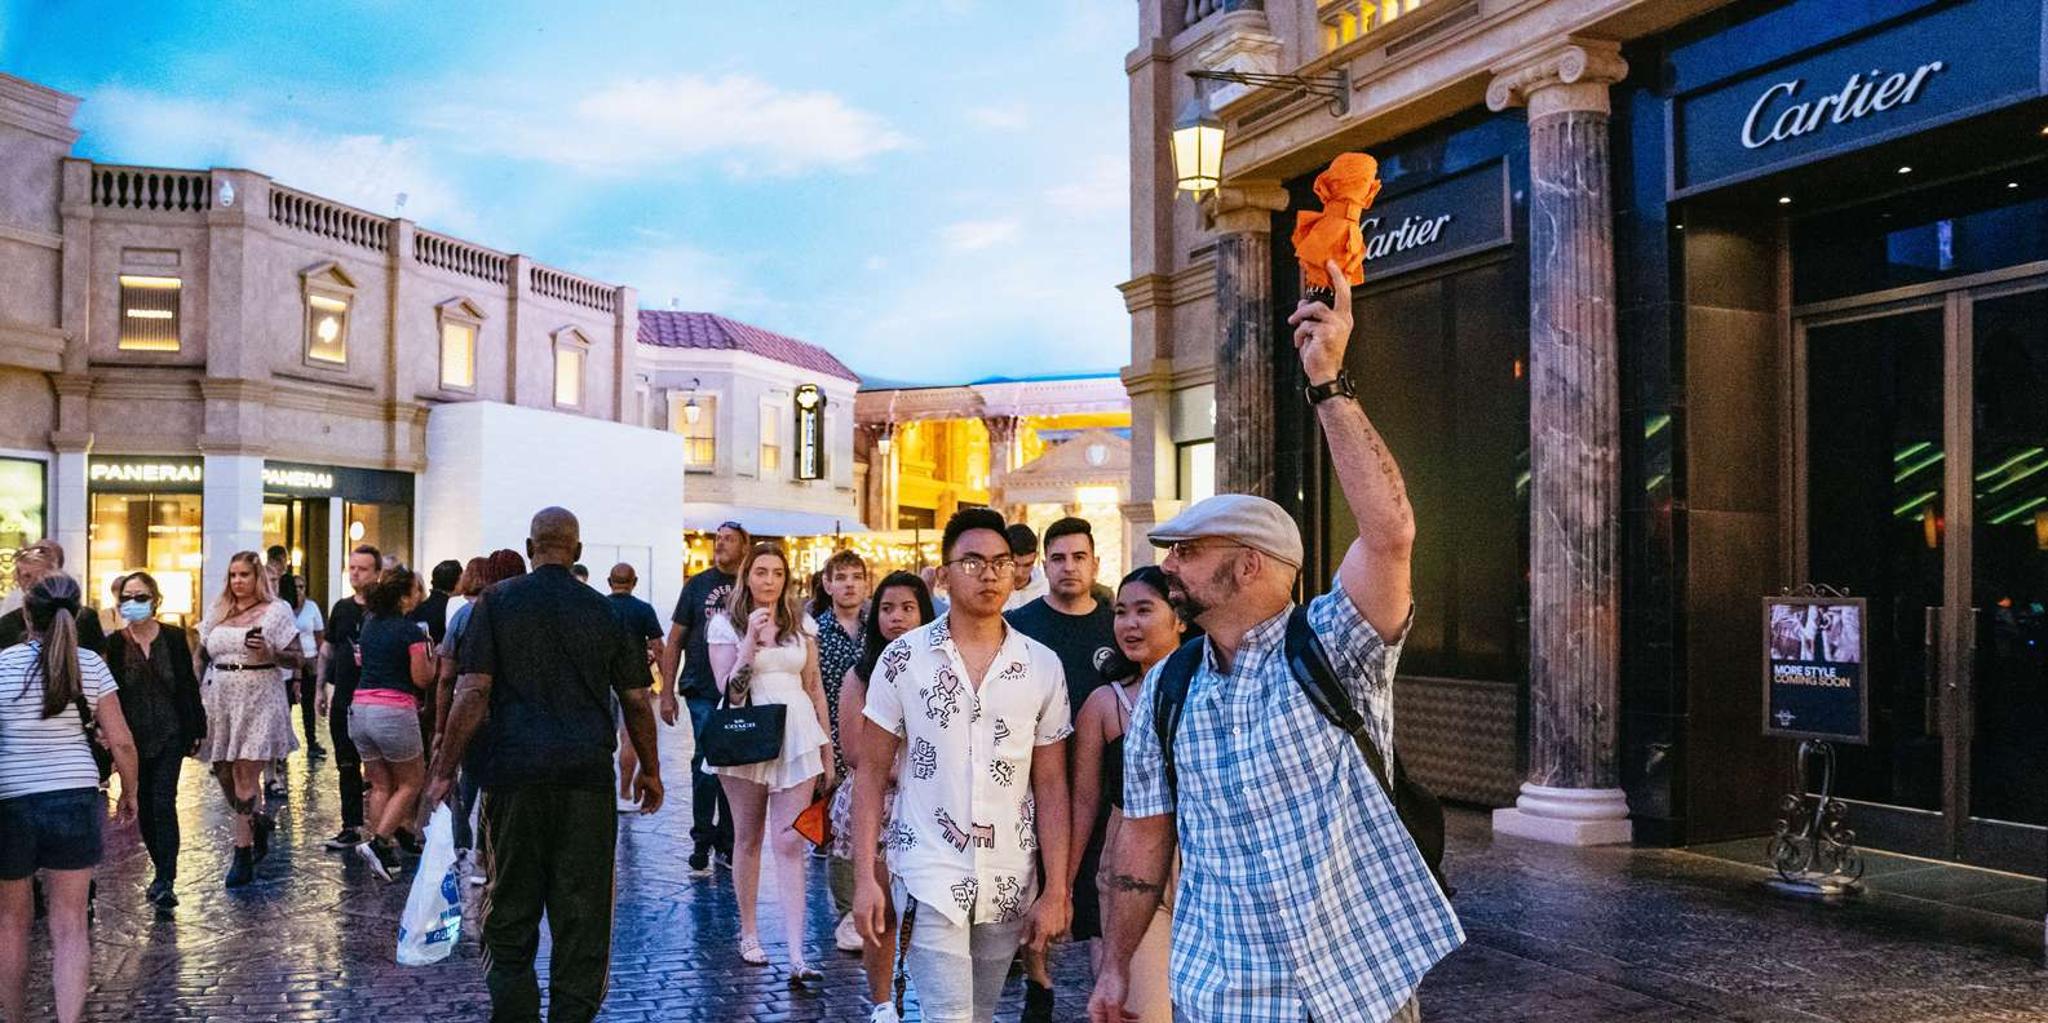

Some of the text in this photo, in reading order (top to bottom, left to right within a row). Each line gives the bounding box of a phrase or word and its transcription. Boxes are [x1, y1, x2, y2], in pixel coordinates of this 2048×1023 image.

[1741, 60, 1943, 149] Cartier
[90, 464, 201, 481] PANERAI
[262, 469, 333, 489] PANERAI
[1774, 664, 1837, 678] MORE STYLE
[1774, 674, 1851, 688] COMING SOON
